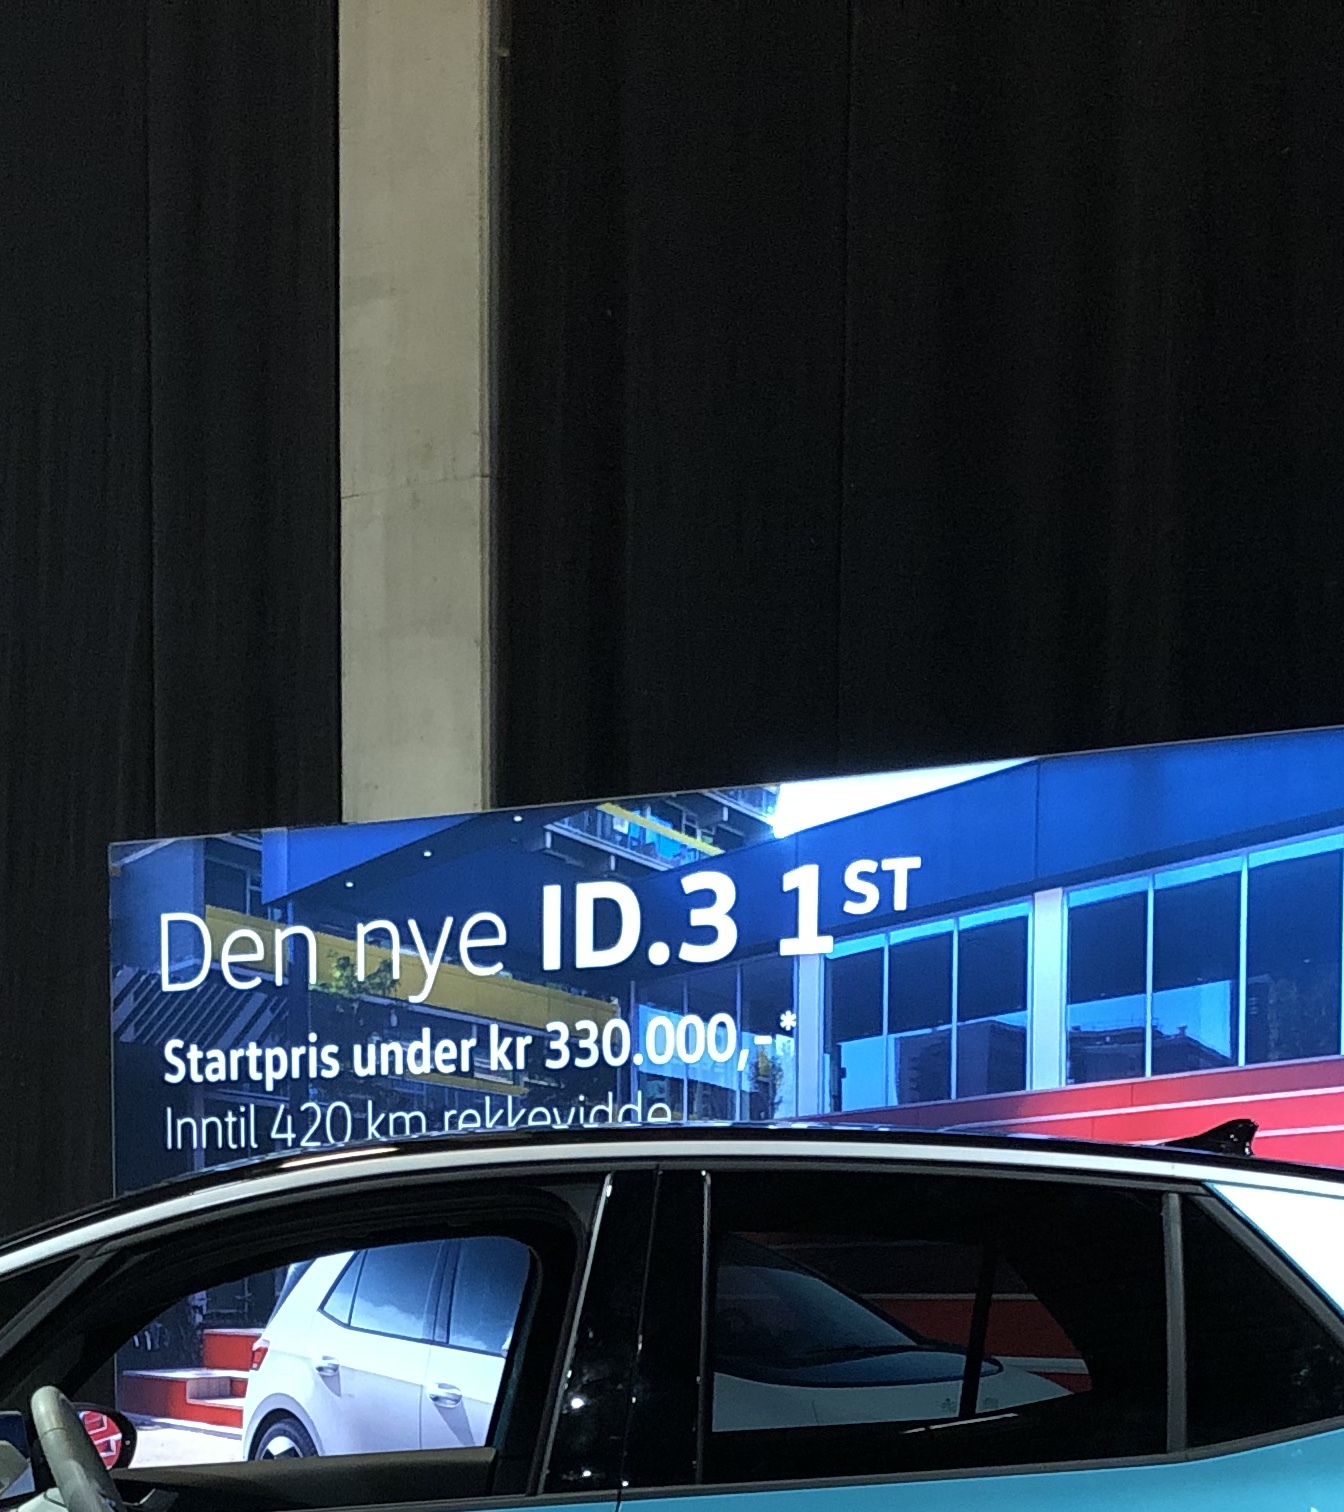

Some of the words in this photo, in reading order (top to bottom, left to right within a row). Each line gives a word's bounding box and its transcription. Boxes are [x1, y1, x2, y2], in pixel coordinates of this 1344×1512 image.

[160, 911, 318, 992] Den
[356, 911, 508, 1004] nye
[542, 870, 738, 971] ID.3
[163, 1031, 341, 1092] Startpris
[353, 1026, 477, 1078] under
[489, 1023, 533, 1071] kr
[166, 1102, 259, 1150] Inntil
[270, 1101, 352, 1147] 420
[367, 1099, 427, 1139] km
